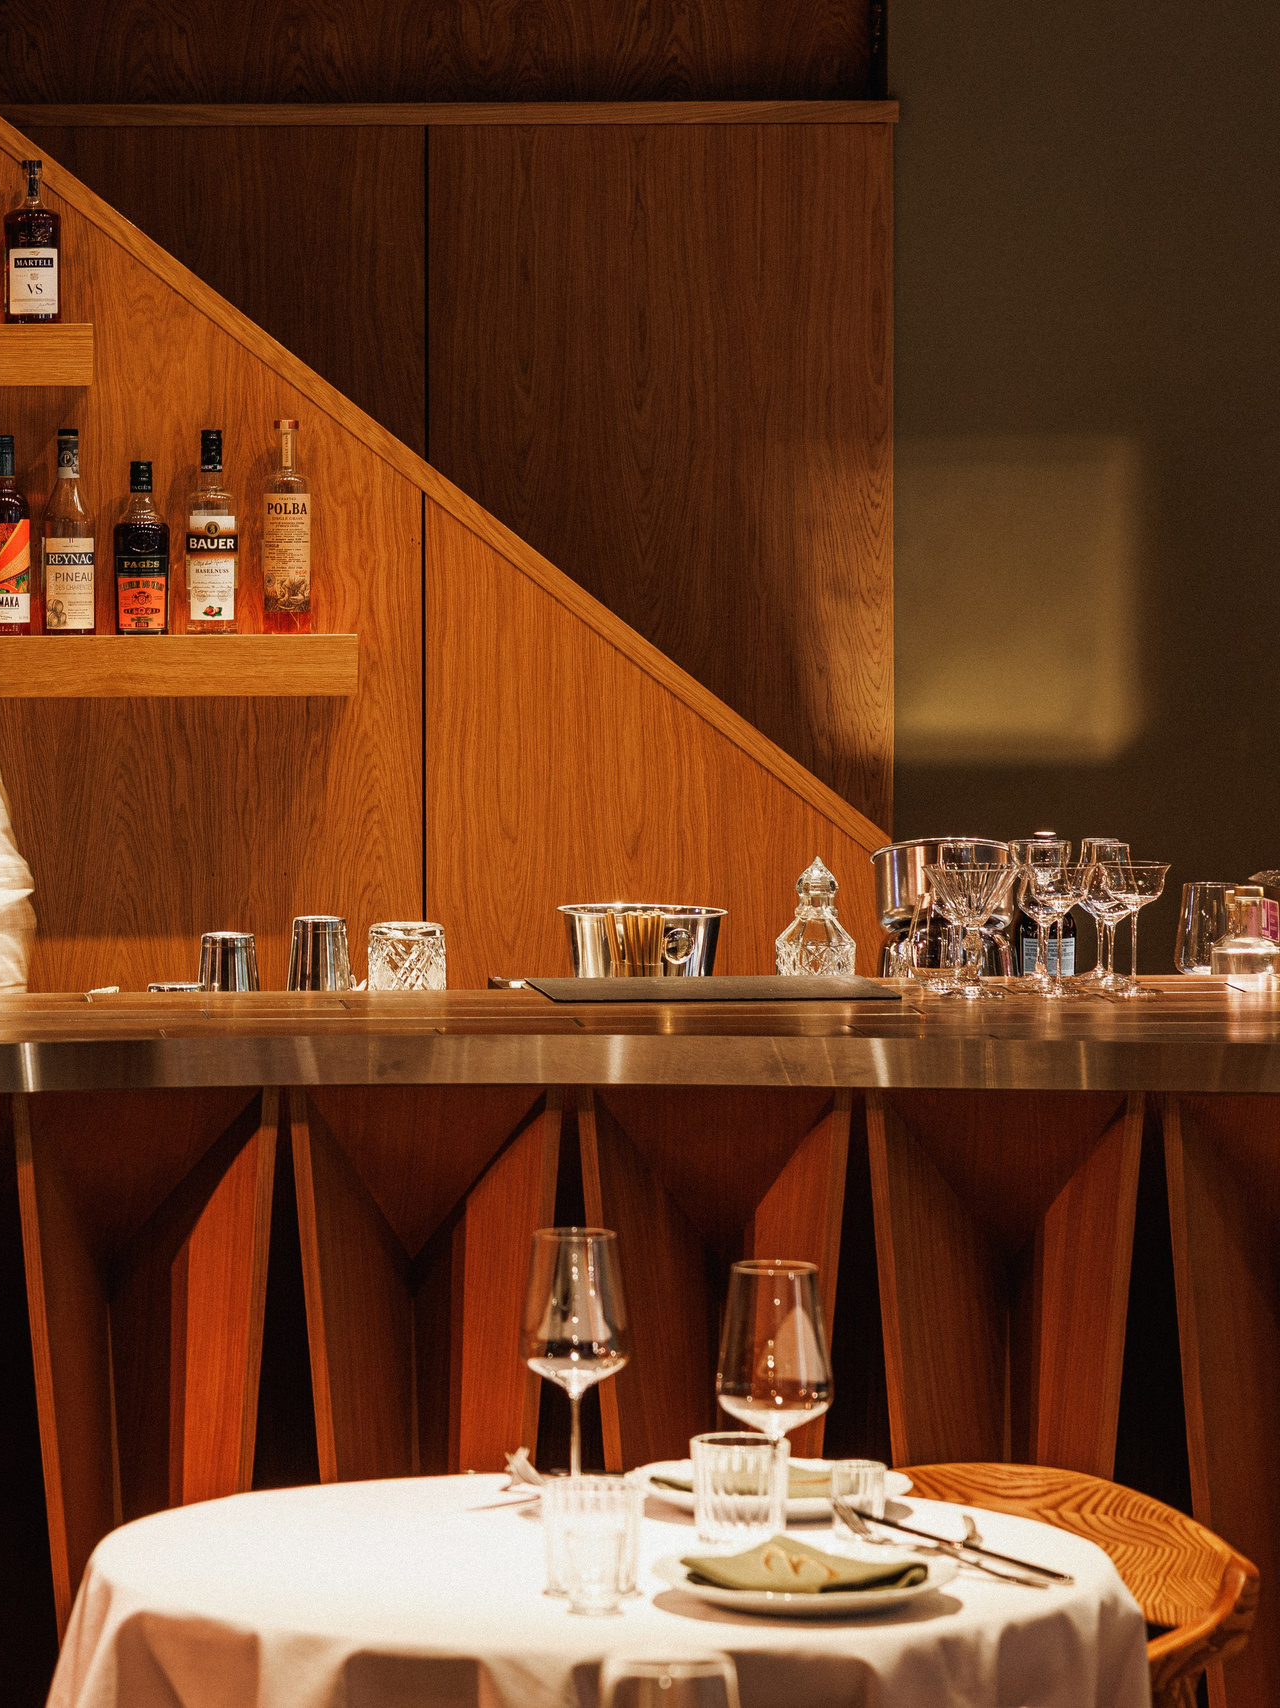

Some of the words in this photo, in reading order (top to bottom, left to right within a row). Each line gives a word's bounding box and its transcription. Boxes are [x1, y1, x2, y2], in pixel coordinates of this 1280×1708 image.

[16, 259, 53, 267] MARTELL
[27, 283, 44, 295] VS
[267, 502, 308, 515] POLBA
[189, 538, 235, 549] BAUER
[49, 553, 93, 565] REYNAC
[123, 560, 160, 569] PAGÈS
[55, 572, 93, 582] PINEAU
